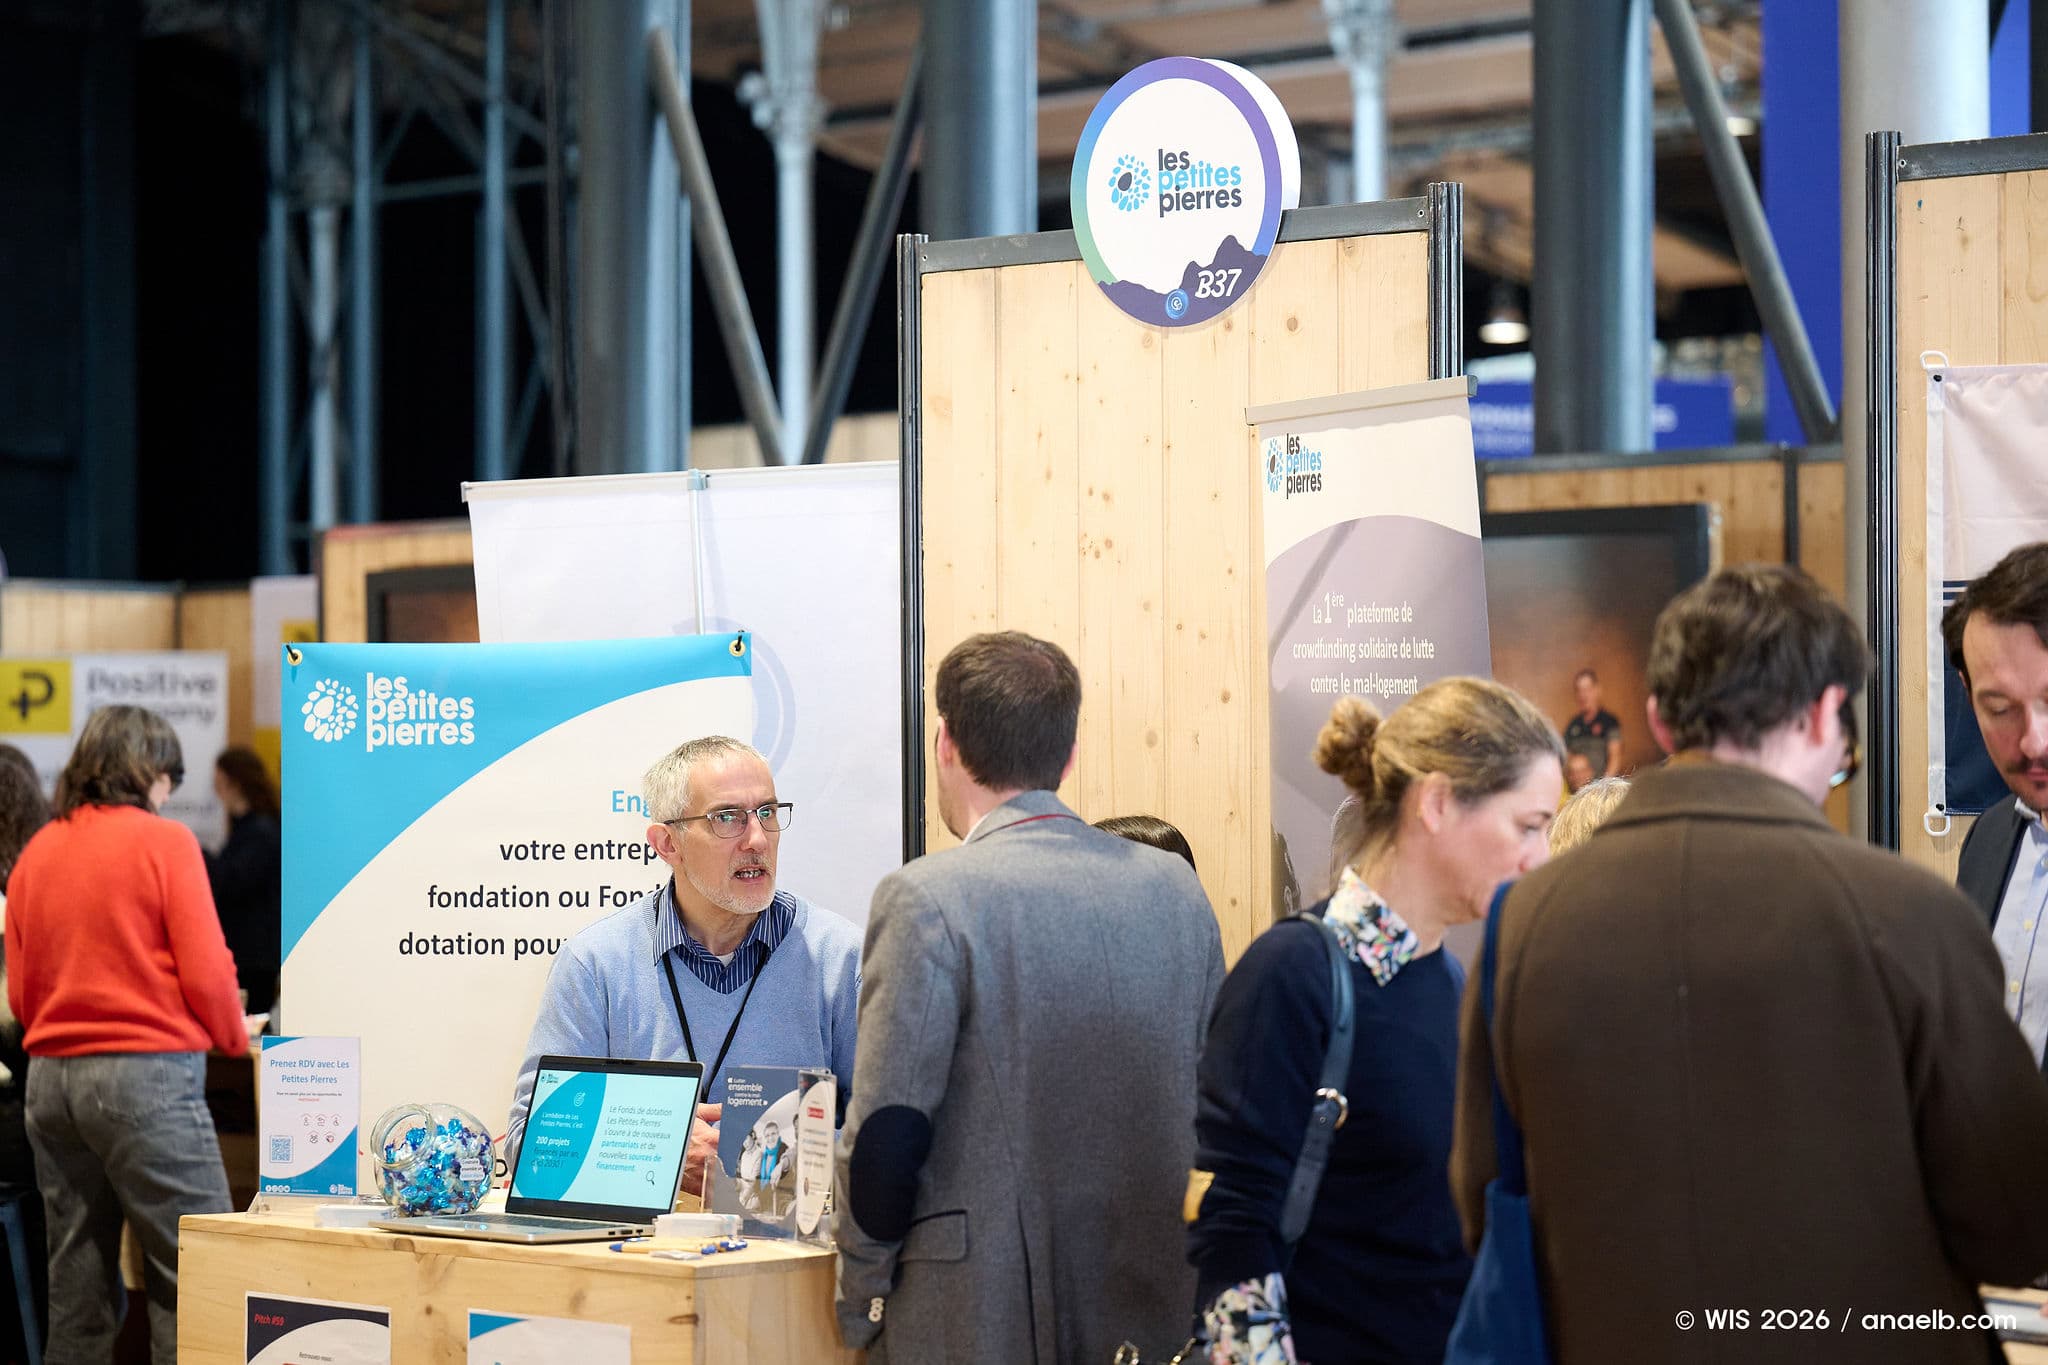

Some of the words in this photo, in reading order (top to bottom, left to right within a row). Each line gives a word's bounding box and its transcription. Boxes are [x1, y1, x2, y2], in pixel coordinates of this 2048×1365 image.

[1158, 149, 1190, 171] les
[1158, 161, 1241, 195] petites
[1159, 185, 1242, 218] pierres
[1195, 269, 1242, 298] B37
[1286, 433, 1300, 455] les
[1286, 446, 1322, 476] petites
[1286, 469, 1322, 499] pierres
[1347, 602, 1399, 628] plateforme
[1401, 601, 1413, 623] de
[1293, 637, 1356, 663] crowdfunding
[1358, 637, 1398, 659] solidaire
[1400, 637, 1411, 659] de
[1413, 637, 1434, 659] lutte
[366, 672, 408, 700] les
[1311, 674, 1338, 694] contre
[1340, 672, 1350, 694] le
[1353, 672, 1418, 699] mal-logement
[366, 689, 475, 724] petites
[366, 720, 475, 752] pierres
[500, 840, 565, 860] votre
[574, 839, 658, 865] entrep
[428, 885, 549, 908] fondation
[559, 890, 589, 908] ou
[599, 885, 660, 908] Fon
[399, 932, 504, 955] dotation
[514, 937, 567, 960] pou
[271, 1060, 296, 1068] Prenez
[299, 1060, 315, 1068] RDV
[337, 1060, 350, 1068] Les
[282, 1075, 308, 1083] Petites
[310, 1075, 338, 1083] Pierres
[728, 1083, 763, 1091] ensemble
[606, 1117, 616, 1125] Les
[618, 1117, 638, 1126] Petites
[640, 1118, 661, 1127] Pierres
[609, 1105, 616, 1113] Le
[618, 1106, 635, 1114] Fonds
[646, 1108, 672, 1116] dotation
[536, 1136, 548, 1144] 200
[548, 1137, 570, 1147] projets
[601, 1141, 639, 1149] partenariats
[641, 1131, 671, 1139] nouveaux
[599, 1151, 627, 1159] nouvelles
[629, 1153, 653, 1161] sources
[653, 1154, 662, 1162] de
[254, 1314, 270, 1324] Pitch
